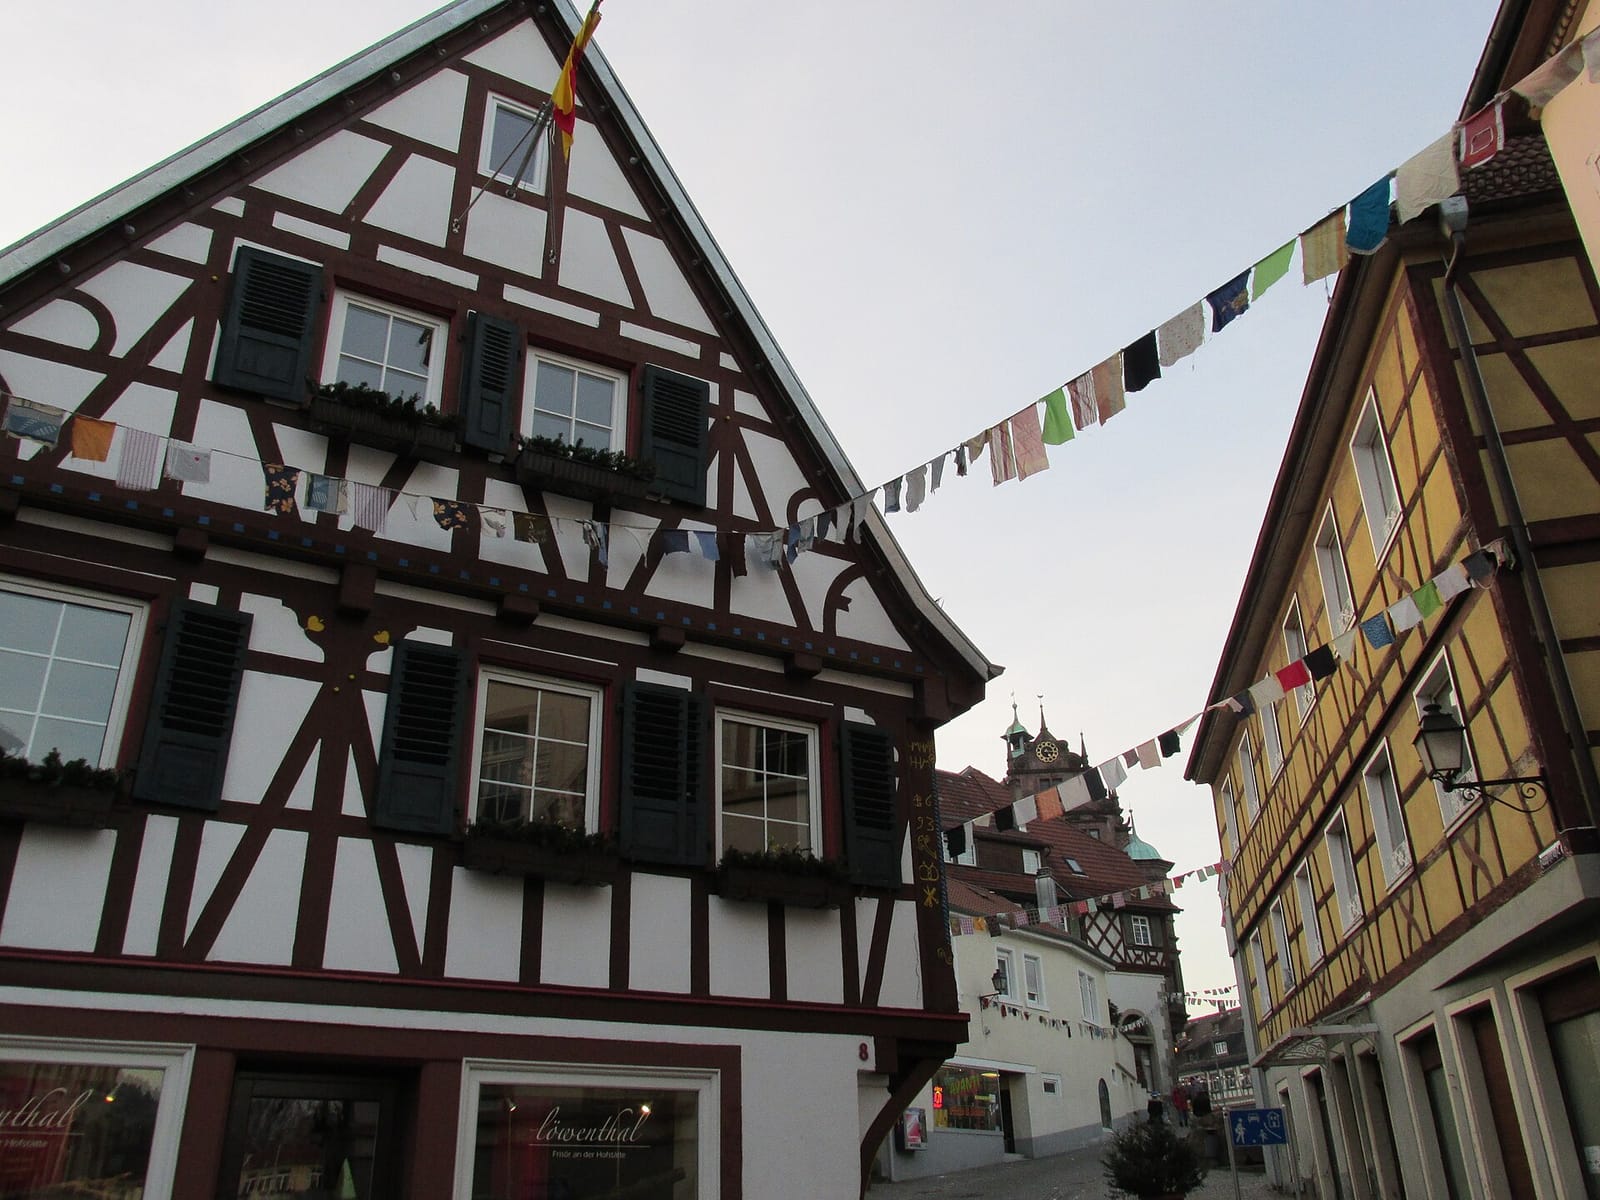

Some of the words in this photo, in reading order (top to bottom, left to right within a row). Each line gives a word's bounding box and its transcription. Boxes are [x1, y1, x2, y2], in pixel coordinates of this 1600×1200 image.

[859, 1042, 868, 1062] 8
[536, 1107, 650, 1142] löwenthal
[573, 1151, 582, 1159] an
[583, 1150, 594, 1159] der
